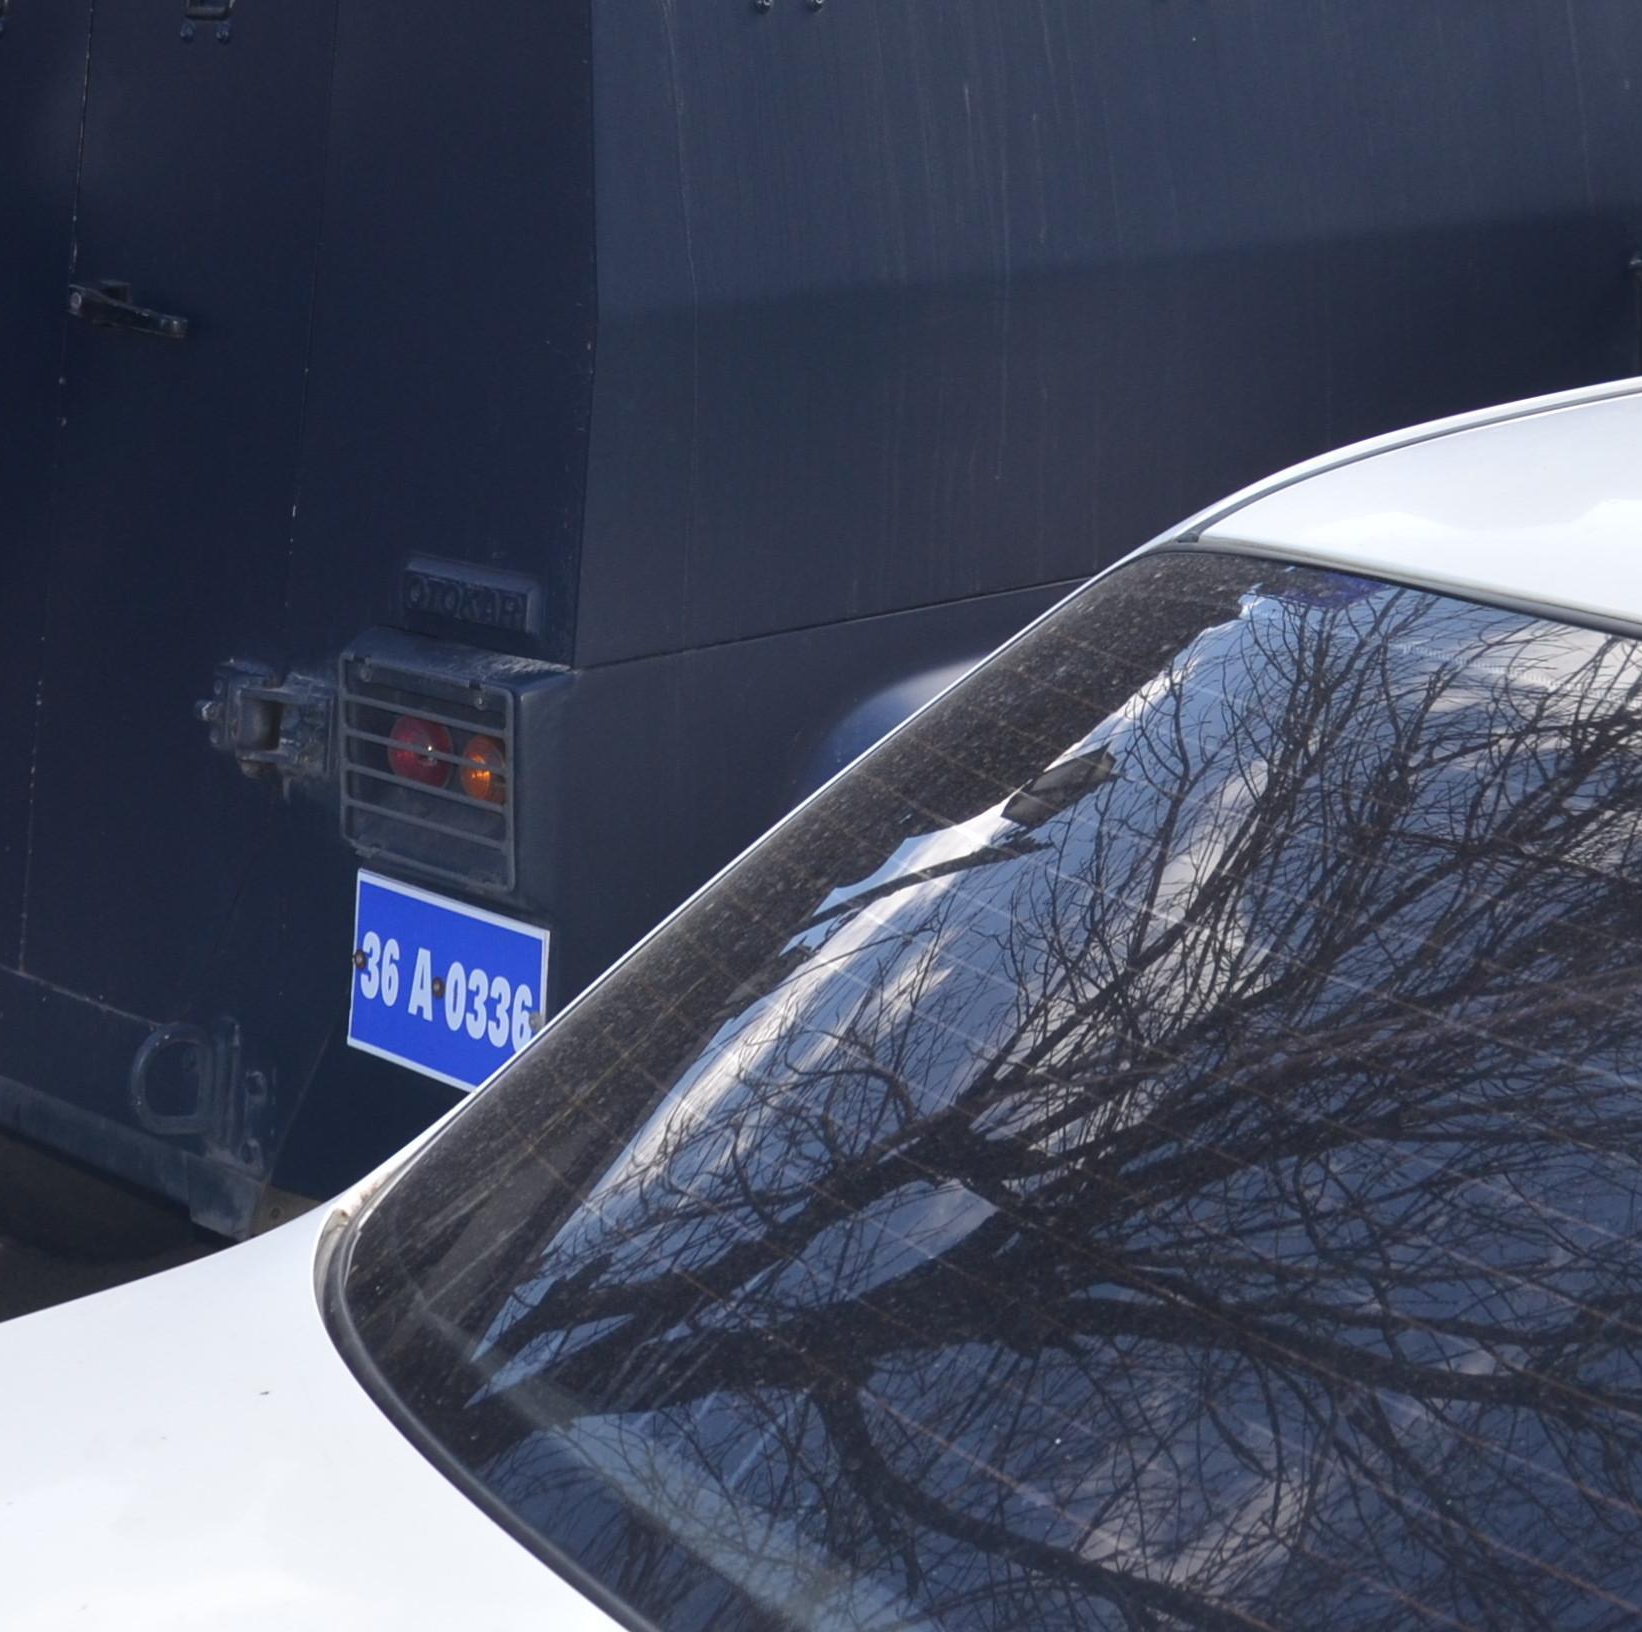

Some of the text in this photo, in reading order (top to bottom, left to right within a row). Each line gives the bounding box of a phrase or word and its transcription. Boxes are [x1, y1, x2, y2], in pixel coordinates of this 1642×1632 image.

[360, 931, 533, 1053] 36 A 0336
